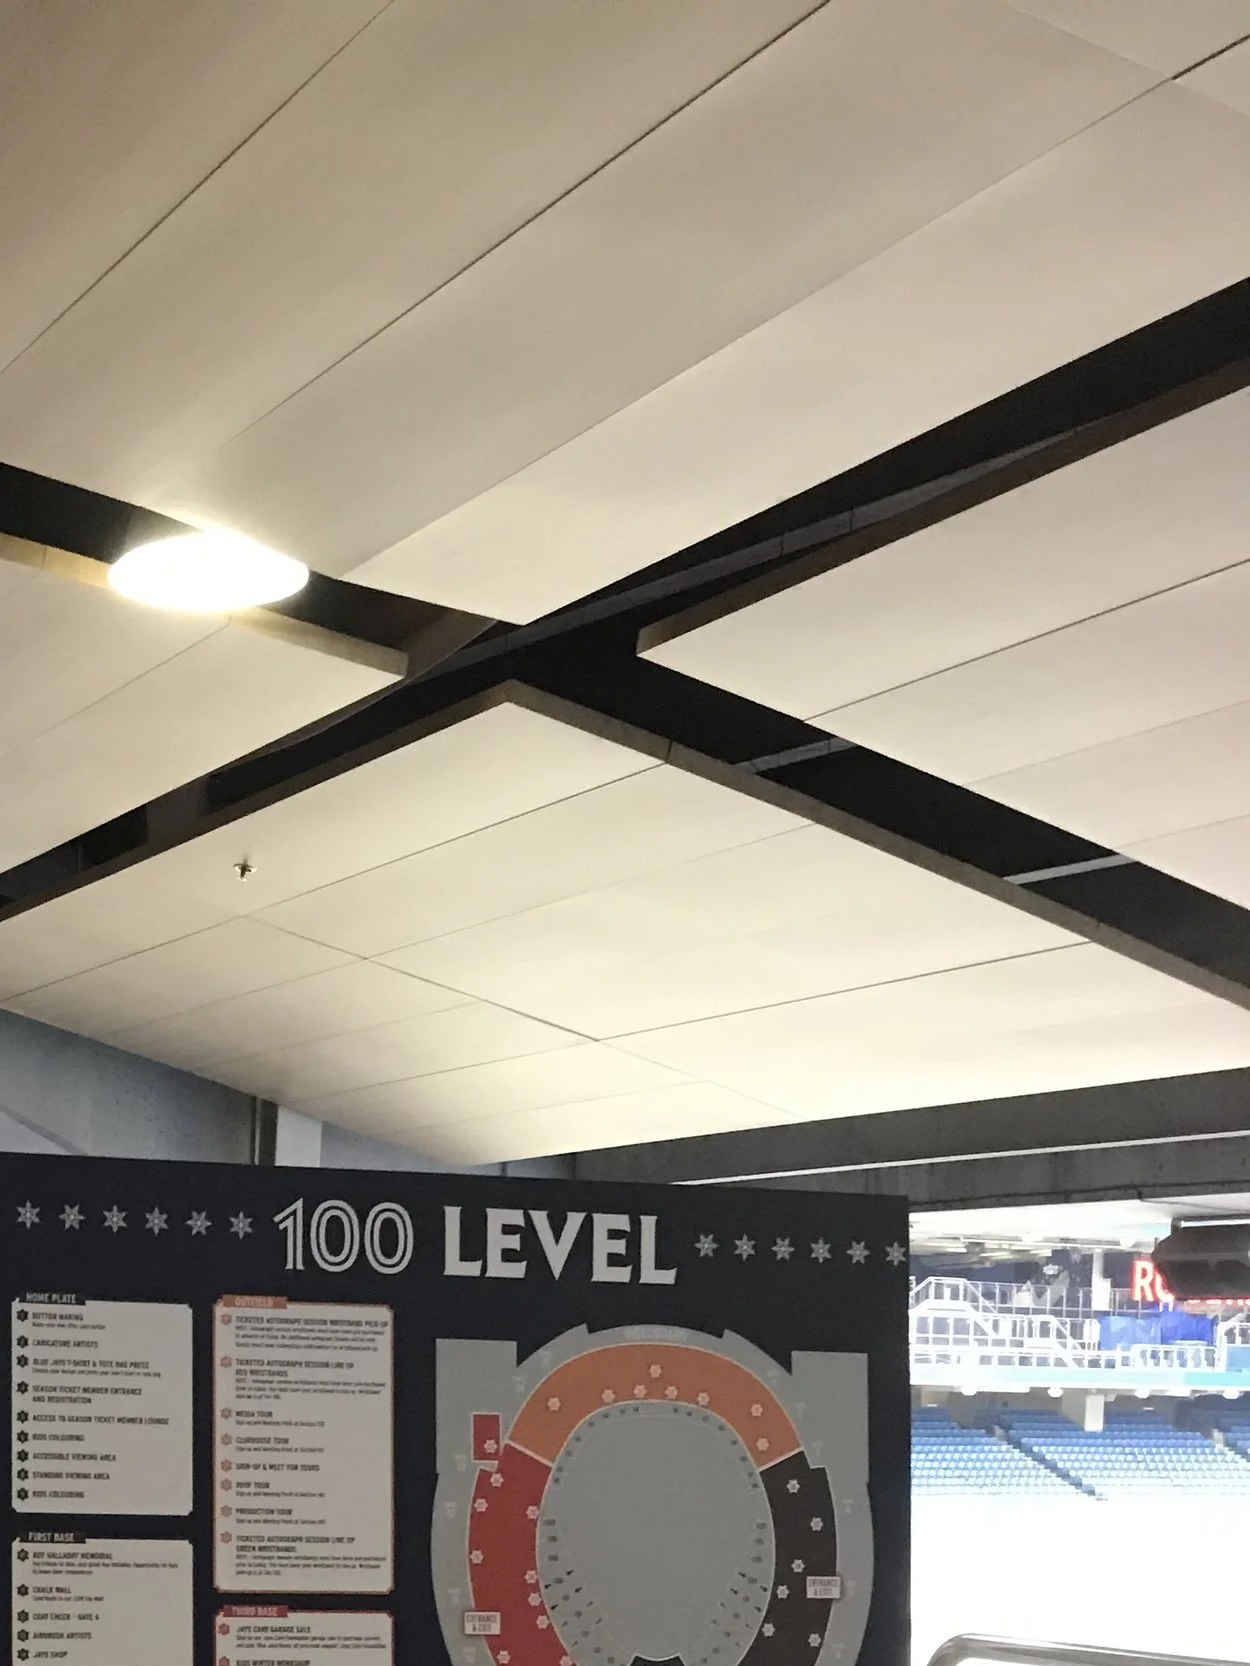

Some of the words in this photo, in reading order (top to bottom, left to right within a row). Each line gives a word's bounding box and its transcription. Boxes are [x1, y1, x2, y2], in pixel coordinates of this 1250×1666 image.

[273, 1199, 415, 1273] 100
[444, 1206, 678, 1286] LEVEL
[26, 1293, 50, 1302] HOME
[52, 1294, 76, 1303] PLATE
[29, 1533, 52, 1542] FIRST
[54, 1533, 74, 1542] BASE
[232, 1608, 255, 1617] THIRD
[257, 1608, 278, 1617] BASE
